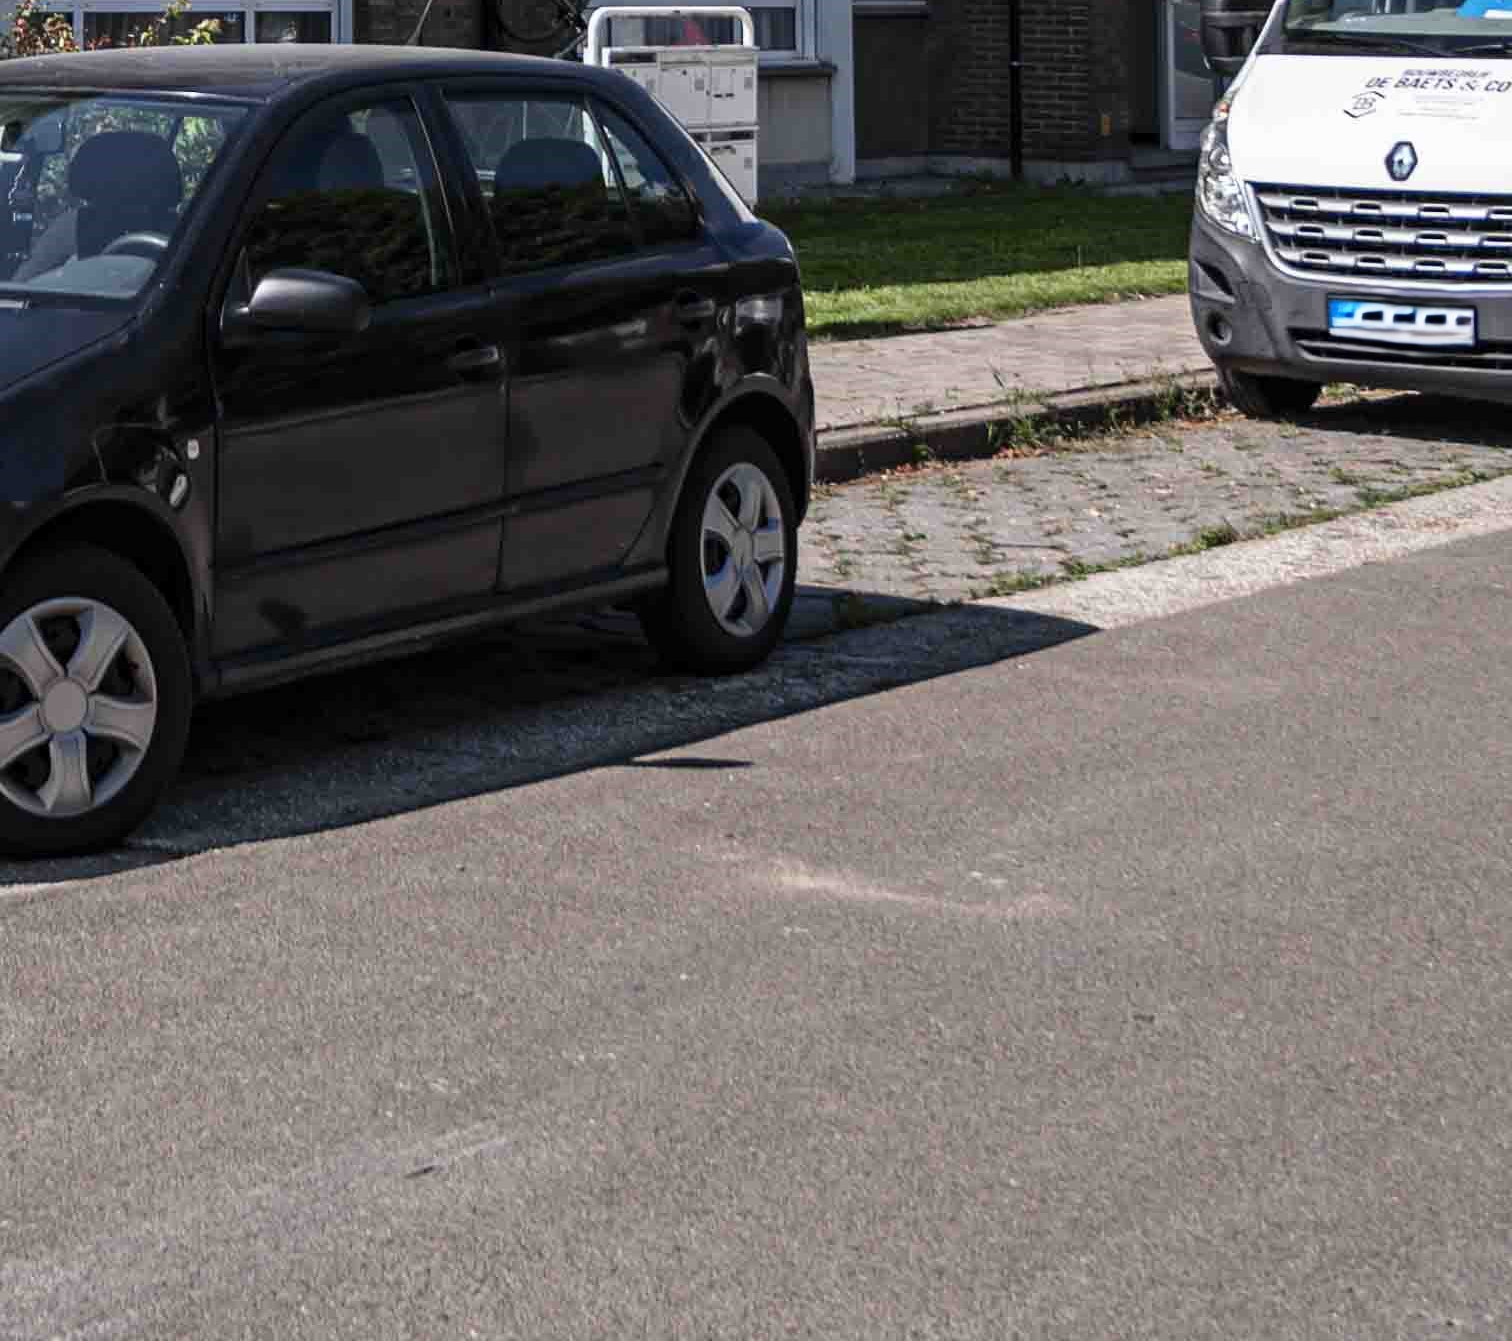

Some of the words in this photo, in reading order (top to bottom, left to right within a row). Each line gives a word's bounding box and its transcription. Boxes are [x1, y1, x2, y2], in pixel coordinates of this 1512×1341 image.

[1365, 77, 1392, 89] DE
[1394, 77, 1457, 90] BAETS
[1484, 80, 1512, 93] CO
